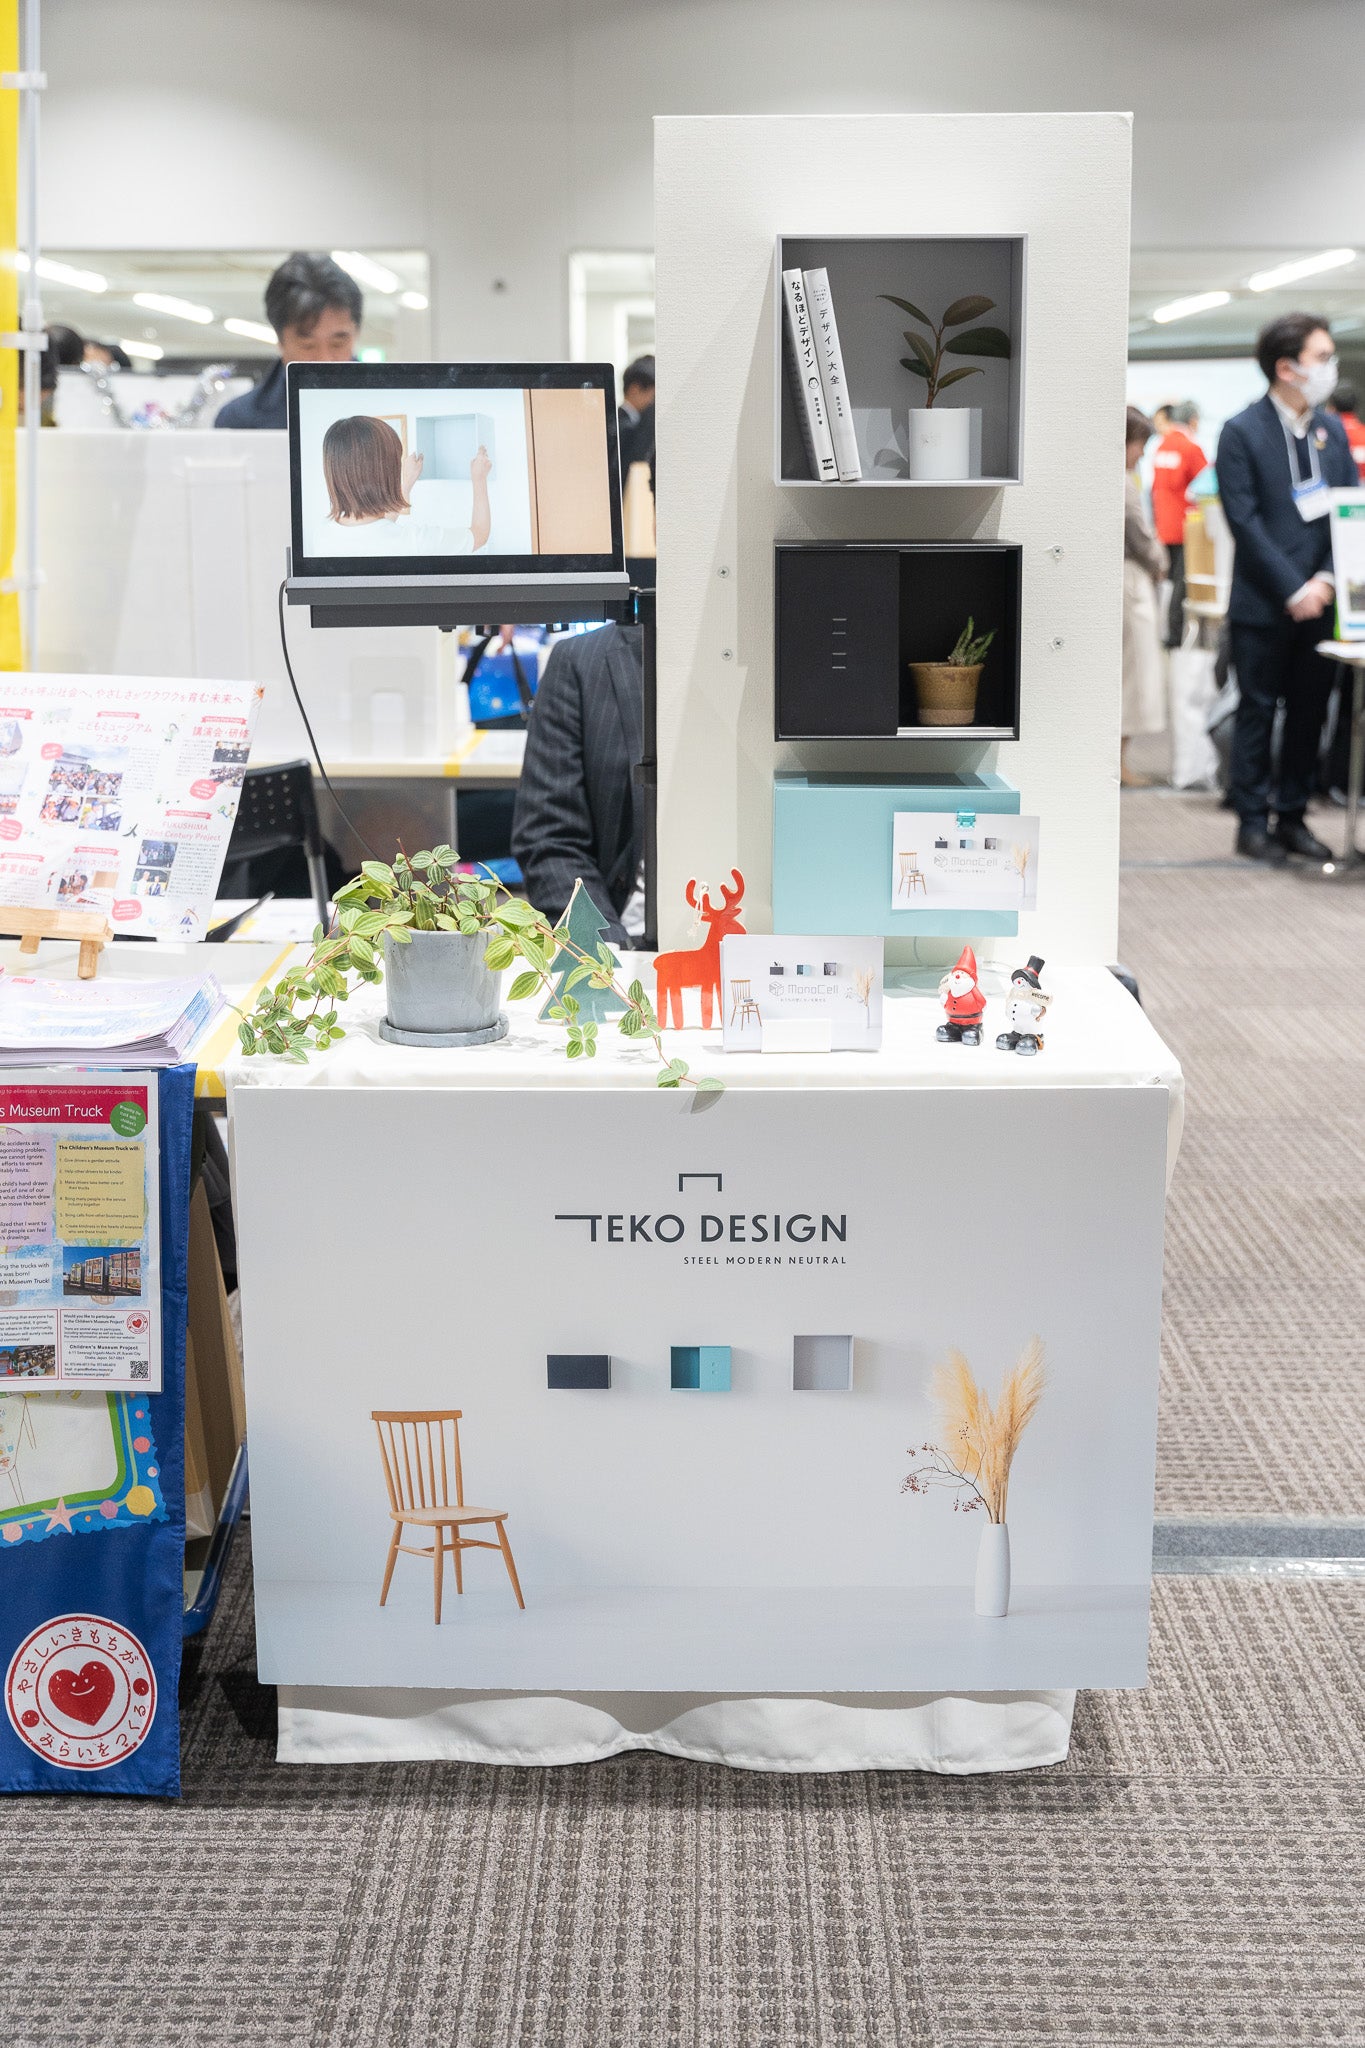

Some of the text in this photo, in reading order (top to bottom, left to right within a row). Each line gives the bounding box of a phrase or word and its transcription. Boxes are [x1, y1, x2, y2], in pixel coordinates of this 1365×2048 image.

[791, 281, 814, 368] なるほどデザイン
[820, 308, 840, 385] デザイン大全
[162, 821, 208, 831] FUKUSHIMA
[164, 829, 195, 839] Century
[195, 832, 222, 842] Project
[787, 984, 839, 995] MonoCell
[1031, 992, 1050, 1002] welcome
[9, 1104, 61, 1116] Museum
[65, 1104, 103, 1117] Truck
[554, 1213, 847, 1243] TEKO DESIGN
[683, 1256, 847, 1265] STEEL MODERN NEUTRAL
[17, 1626, 139, 1694] やさしいきもちが
[39, 1704, 147, 1758] みらいをつくる
